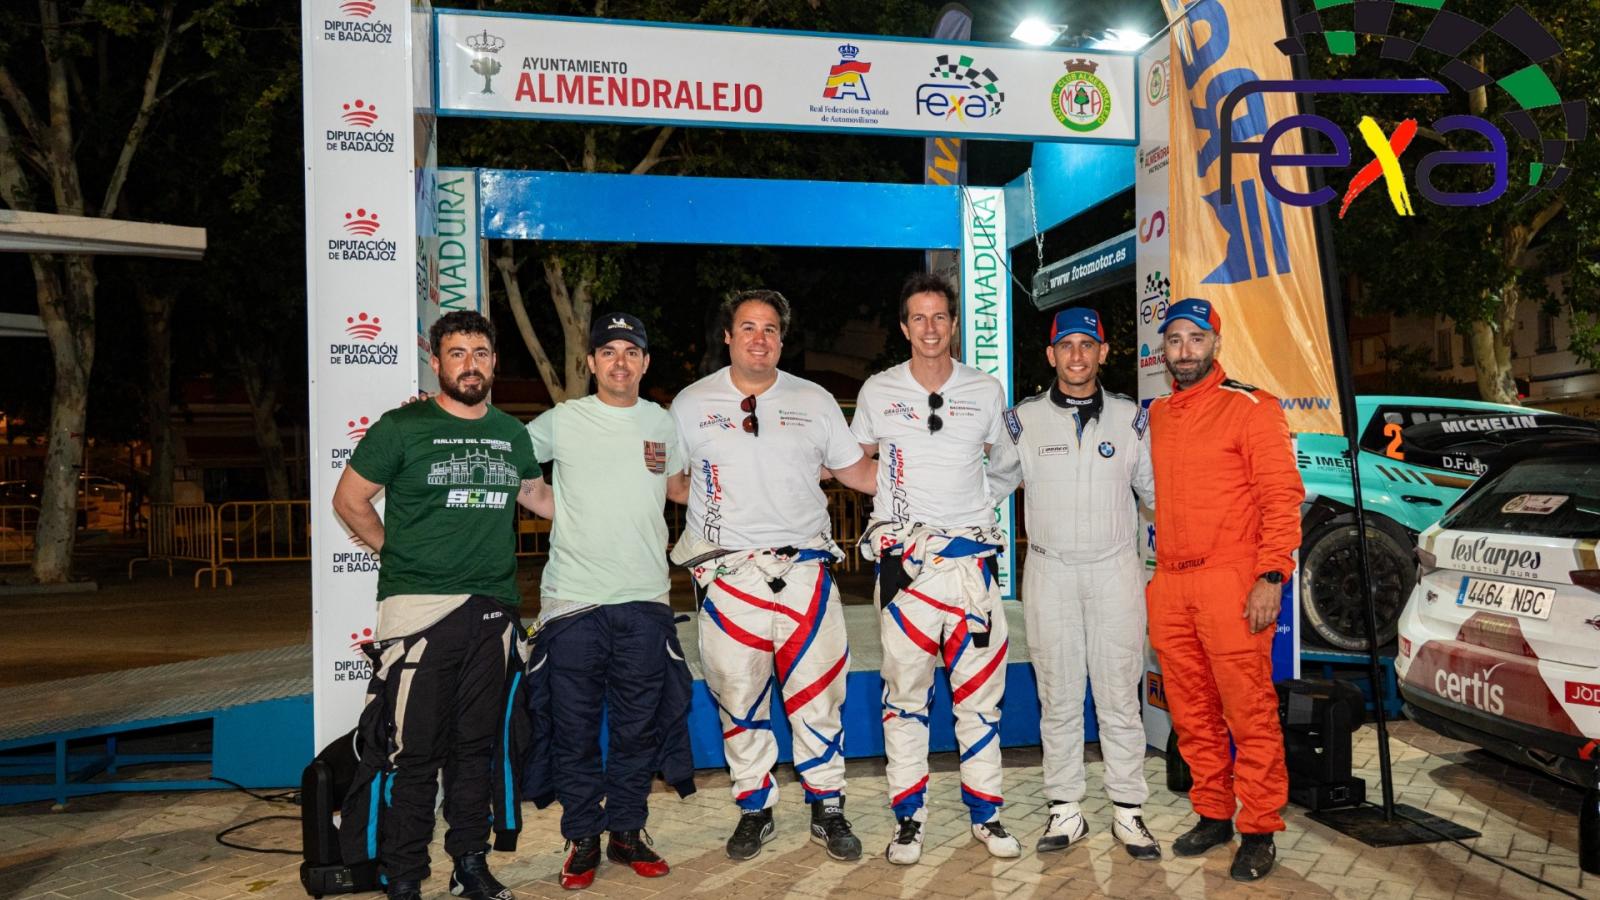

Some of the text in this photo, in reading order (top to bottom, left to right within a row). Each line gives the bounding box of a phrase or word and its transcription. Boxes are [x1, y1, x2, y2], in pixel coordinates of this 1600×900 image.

[324, 20, 392, 34] DIPUTACIÓN
[324, 32, 392, 44] DE BADAJOZ
[523, 56, 628, 74] AYUNTAMIENTO
[515, 72, 763, 113] ALMENDRALEJO
[809, 105, 890, 116] Real Federación Española
[830, 115, 878, 124] Automovilismo
[326, 130, 394, 142] DIPUTACIÓN
[326, 142, 394, 152] DE BADAJOZ
[328, 238, 396, 250] DIPUTACIÓN
[328, 250, 396, 261] DE BADAJOZ
[330, 342, 398, 354] DIPUTACIÓN
[330, 354, 398, 365] DE BADAJOZ
[1441, 415, 1539, 433] MICHELIN
[1383, 423, 1405, 460] 2
[332, 461, 342, 469] DE
[333, 564, 344, 573] DE
[1468, 581, 1545, 614] 4464 NBC
[334, 673, 346, 681] DE
[1435, 662, 1506, 716] certis
